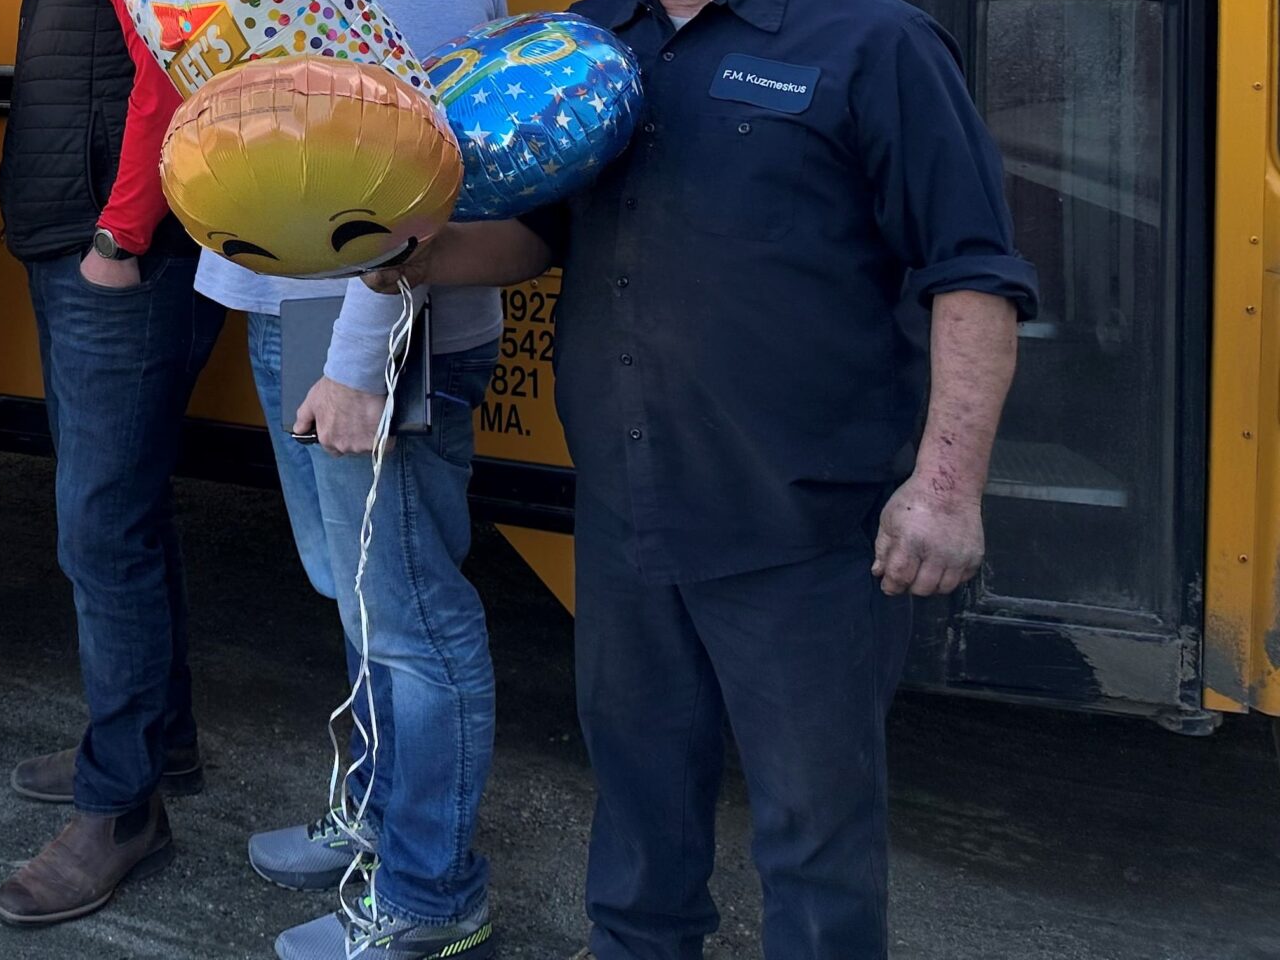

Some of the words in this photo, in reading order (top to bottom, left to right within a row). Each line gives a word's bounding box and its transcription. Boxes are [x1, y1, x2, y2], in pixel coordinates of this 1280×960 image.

[174, 24, 232, 94] LET'S
[745, 73, 807, 93] Kuzmeskus
[480, 401, 531, 436] MA.
